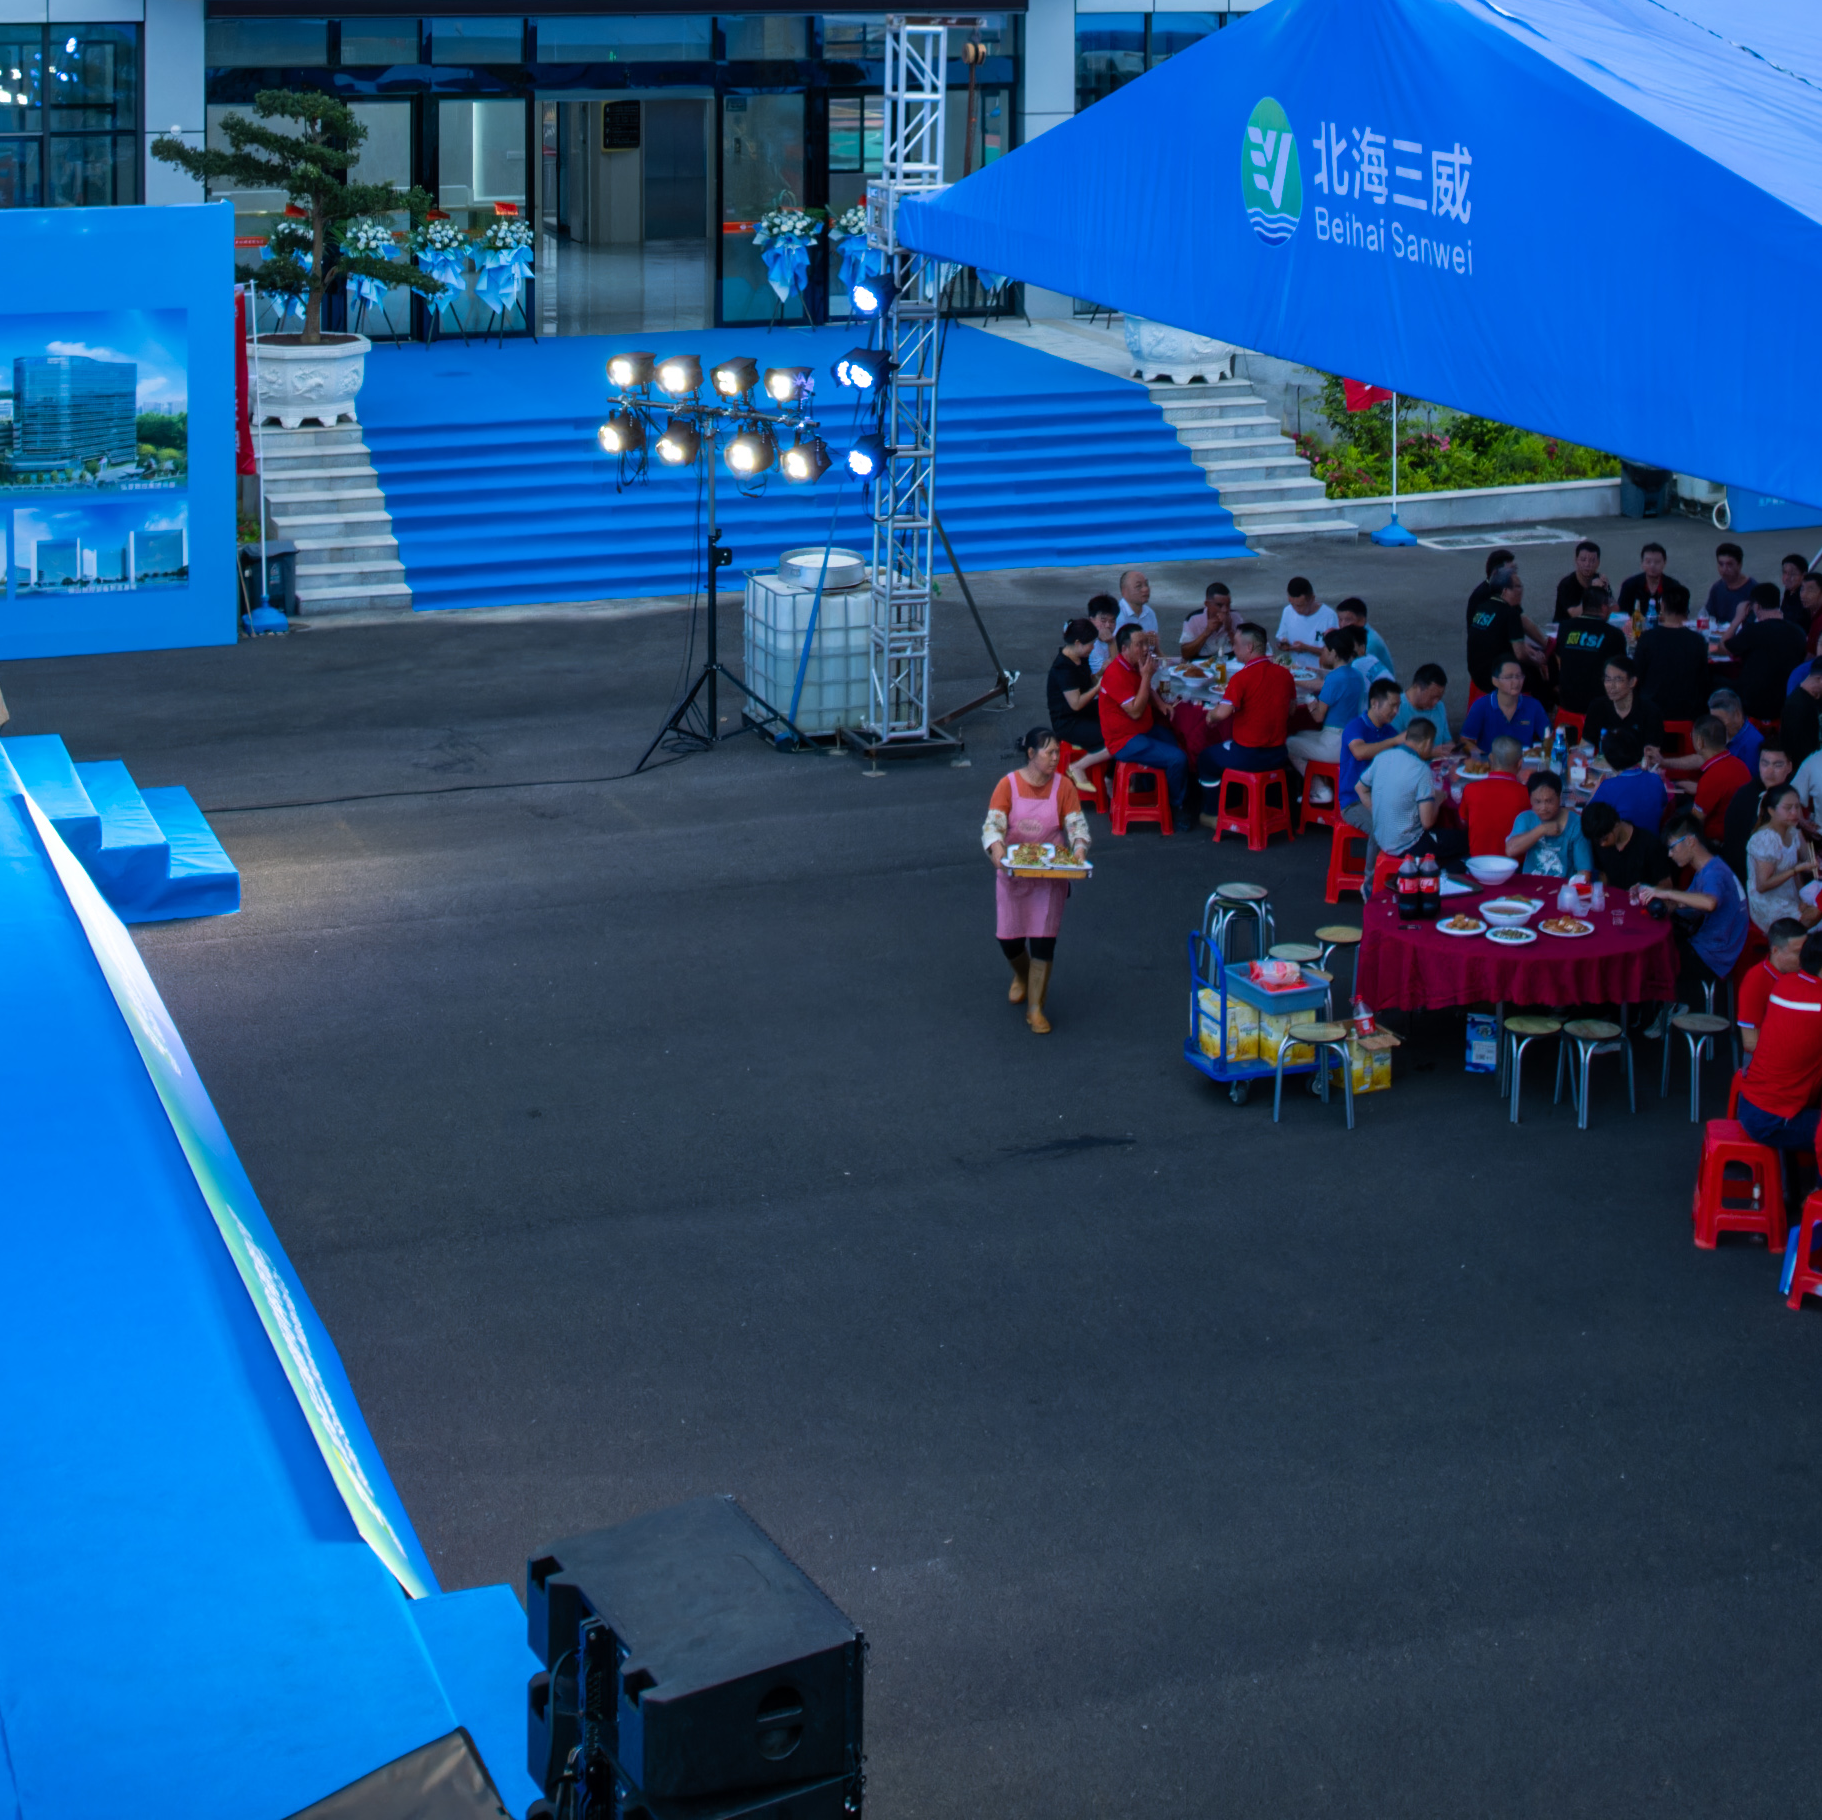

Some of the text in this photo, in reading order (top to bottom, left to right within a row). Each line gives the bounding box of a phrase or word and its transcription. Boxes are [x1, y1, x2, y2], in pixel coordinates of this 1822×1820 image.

[1312, 121, 1473, 225] 北海三威
[1315, 206, 1473, 276] Beihai Sanwei
